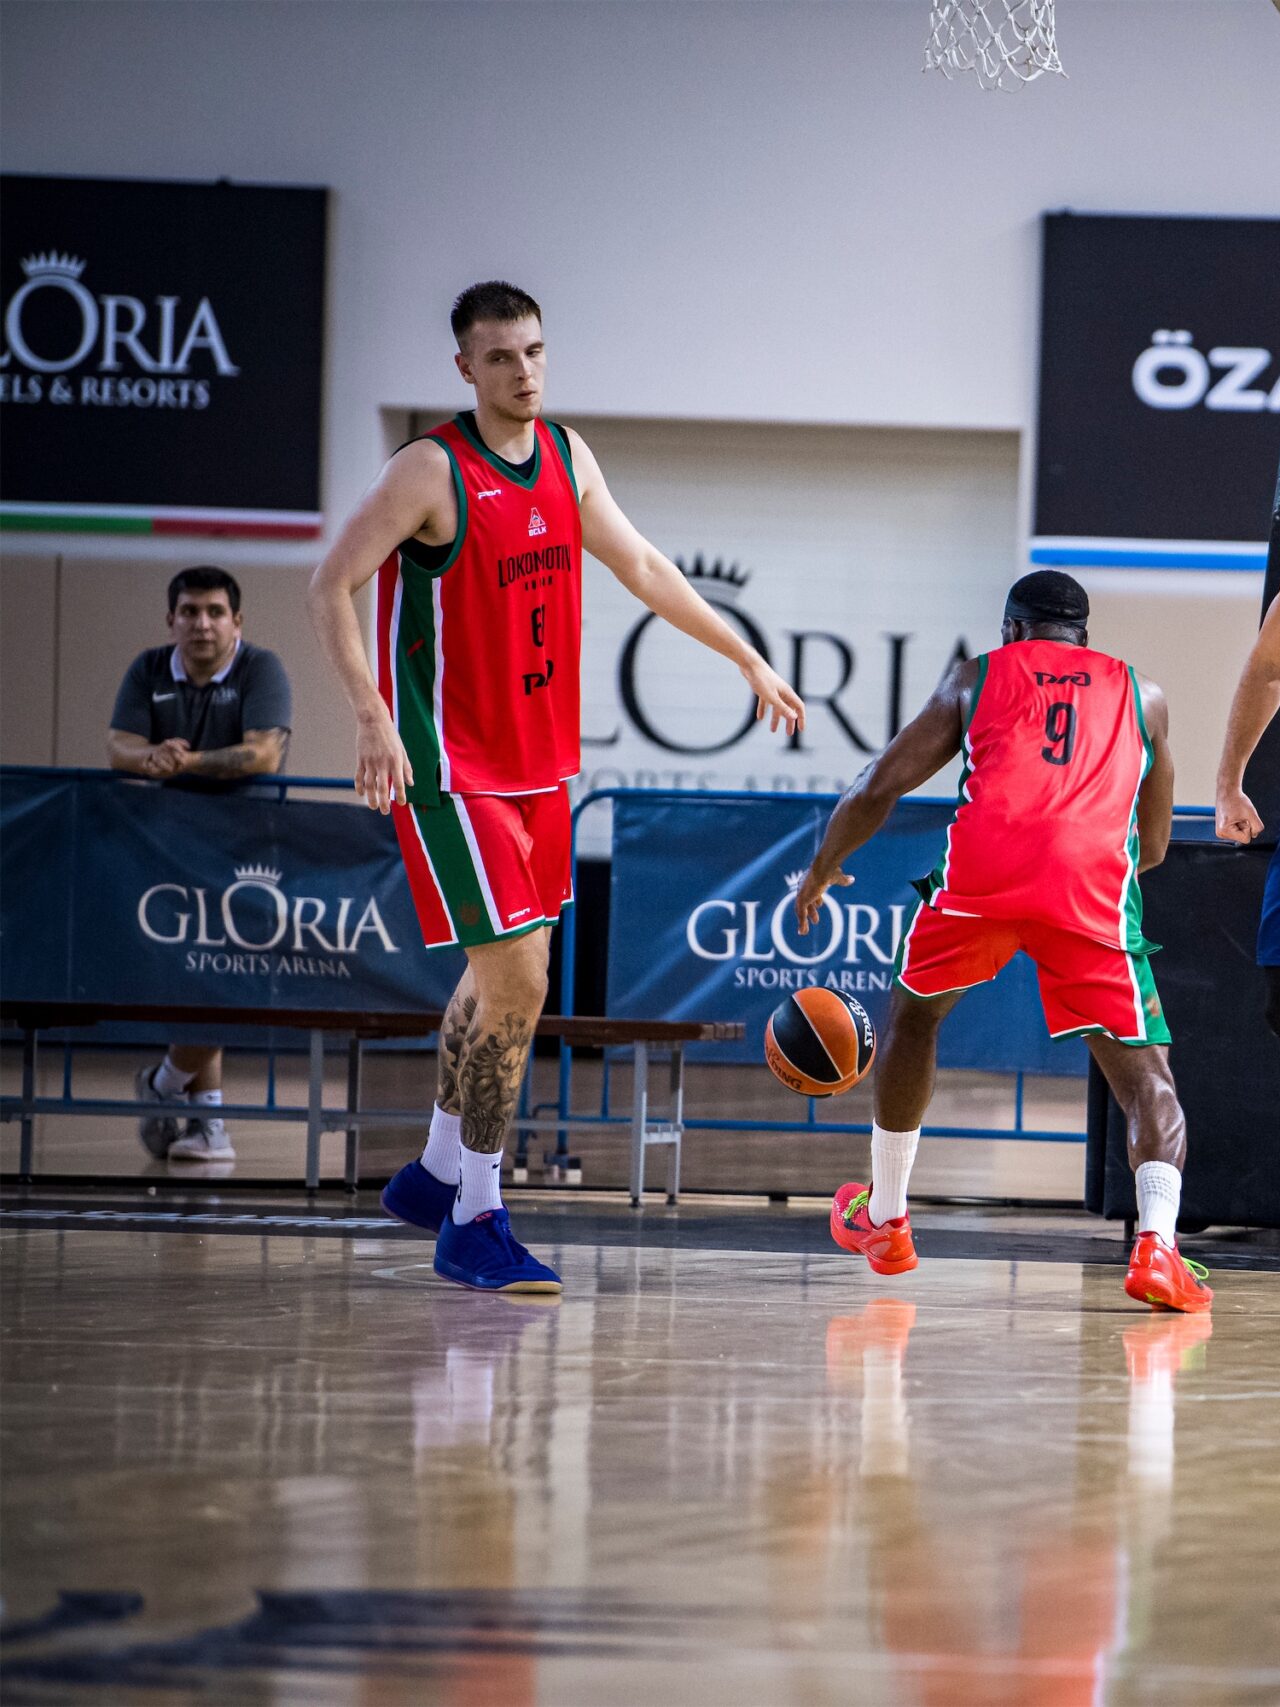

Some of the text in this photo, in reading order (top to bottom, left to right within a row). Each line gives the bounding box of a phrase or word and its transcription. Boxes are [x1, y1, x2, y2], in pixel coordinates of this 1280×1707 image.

[0, 273, 241, 377] ORIA
[0, 374, 211, 410] ELS & RESORTS
[1041, 701, 1077, 766] 9
[137, 879, 401, 954] GLORIA
[686, 889, 906, 965] GLORI
[185, 950, 351, 979] SPORTS ARENA
[734, 966, 818, 989] SPORTS
